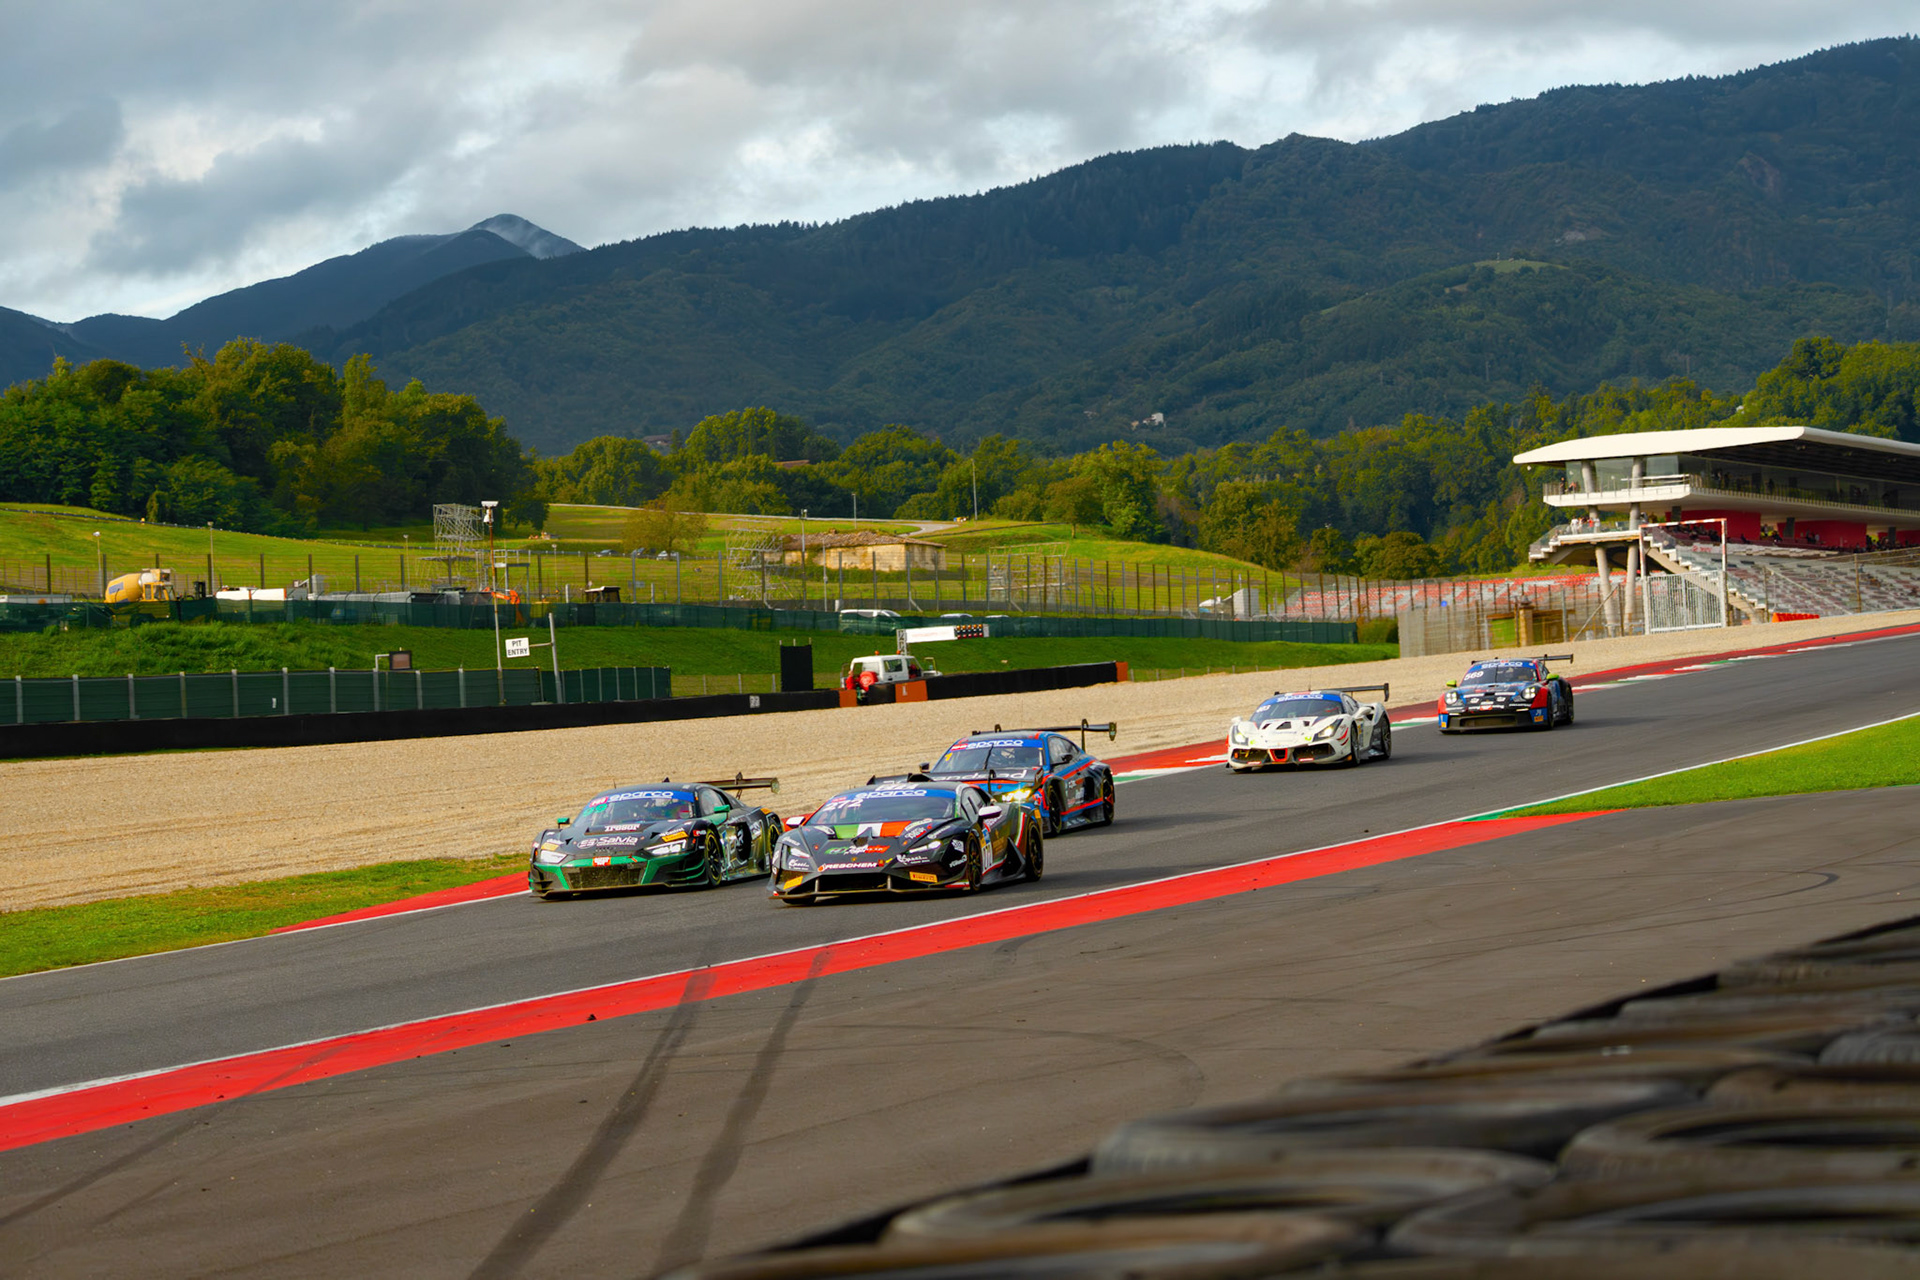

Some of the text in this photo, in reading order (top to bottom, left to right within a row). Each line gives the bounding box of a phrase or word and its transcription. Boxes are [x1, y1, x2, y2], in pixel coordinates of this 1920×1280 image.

[507, 648, 528, 656] ENTRY
[1480, 661, 1523, 670] sparco
[1463, 670, 1485, 681] 569
[1277, 693, 1324, 702] sparco
[965, 739, 1024, 750] sparco
[607, 791, 673, 802] sparco
[853, 789, 928, 800] sparco
[822, 799, 864, 812] 272
[599, 835, 639, 845] Salvia
